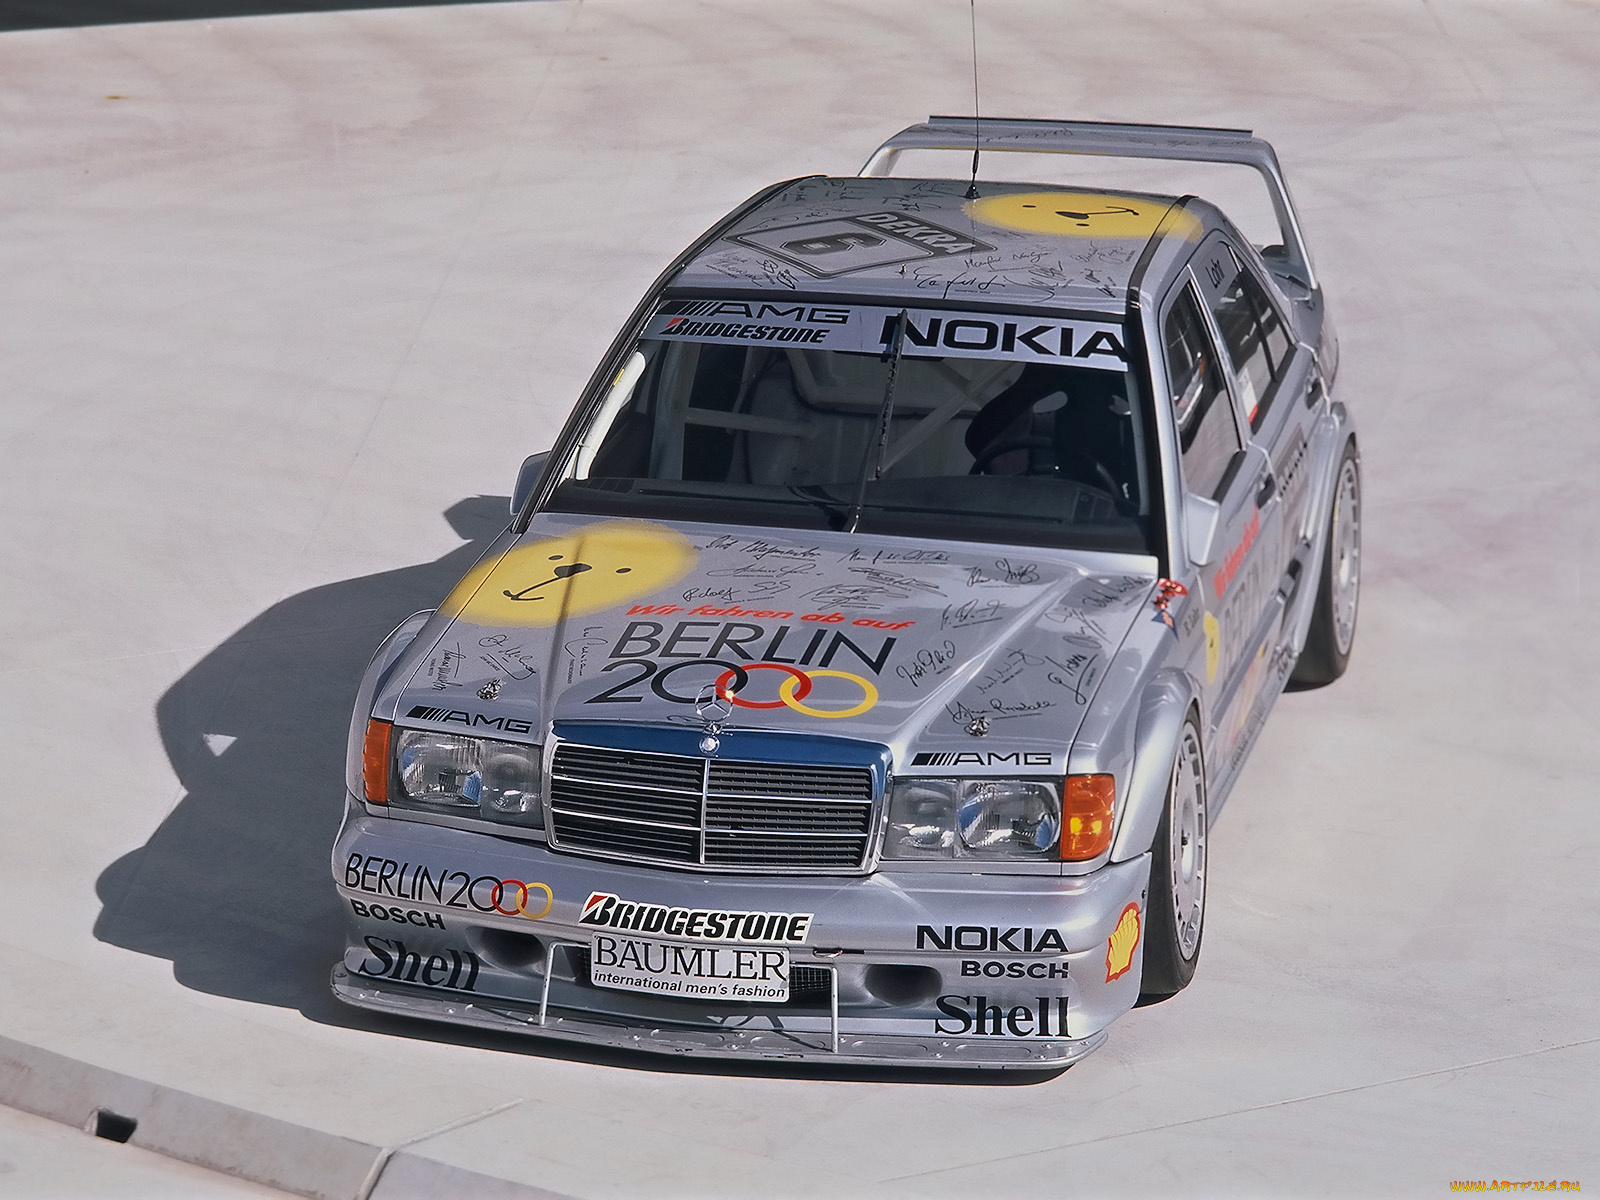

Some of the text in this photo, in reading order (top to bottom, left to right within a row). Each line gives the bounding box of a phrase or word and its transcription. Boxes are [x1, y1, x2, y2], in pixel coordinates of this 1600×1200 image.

[780, 232, 887, 255] 6
[856, 212, 977, 254] DEKRA
[706, 302, 851, 325] AMG
[659, 318, 831, 344] BRIDGESTONE
[879, 315, 1128, 363] NOKIA
[625, 604, 917, 631] Wir fahren ab auf
[608, 621, 897, 676] BERLIN
[583, 659, 879, 718] 2000
[441, 709, 533, 734] AMG
[952, 752, 1052, 766] AMG
[350, 898, 447, 931] BOSCH
[579, 896, 810, 942] BRIDGESTONE
[916, 925, 1069, 953] NOKIA
[357, 935, 480, 992] Shell
[594, 935, 787, 982] BÄUMLER
[960, 960, 1069, 979] BOSCH
[594, 970, 785, 998] international men's fashion
[934, 995, 1072, 1038] Shell
